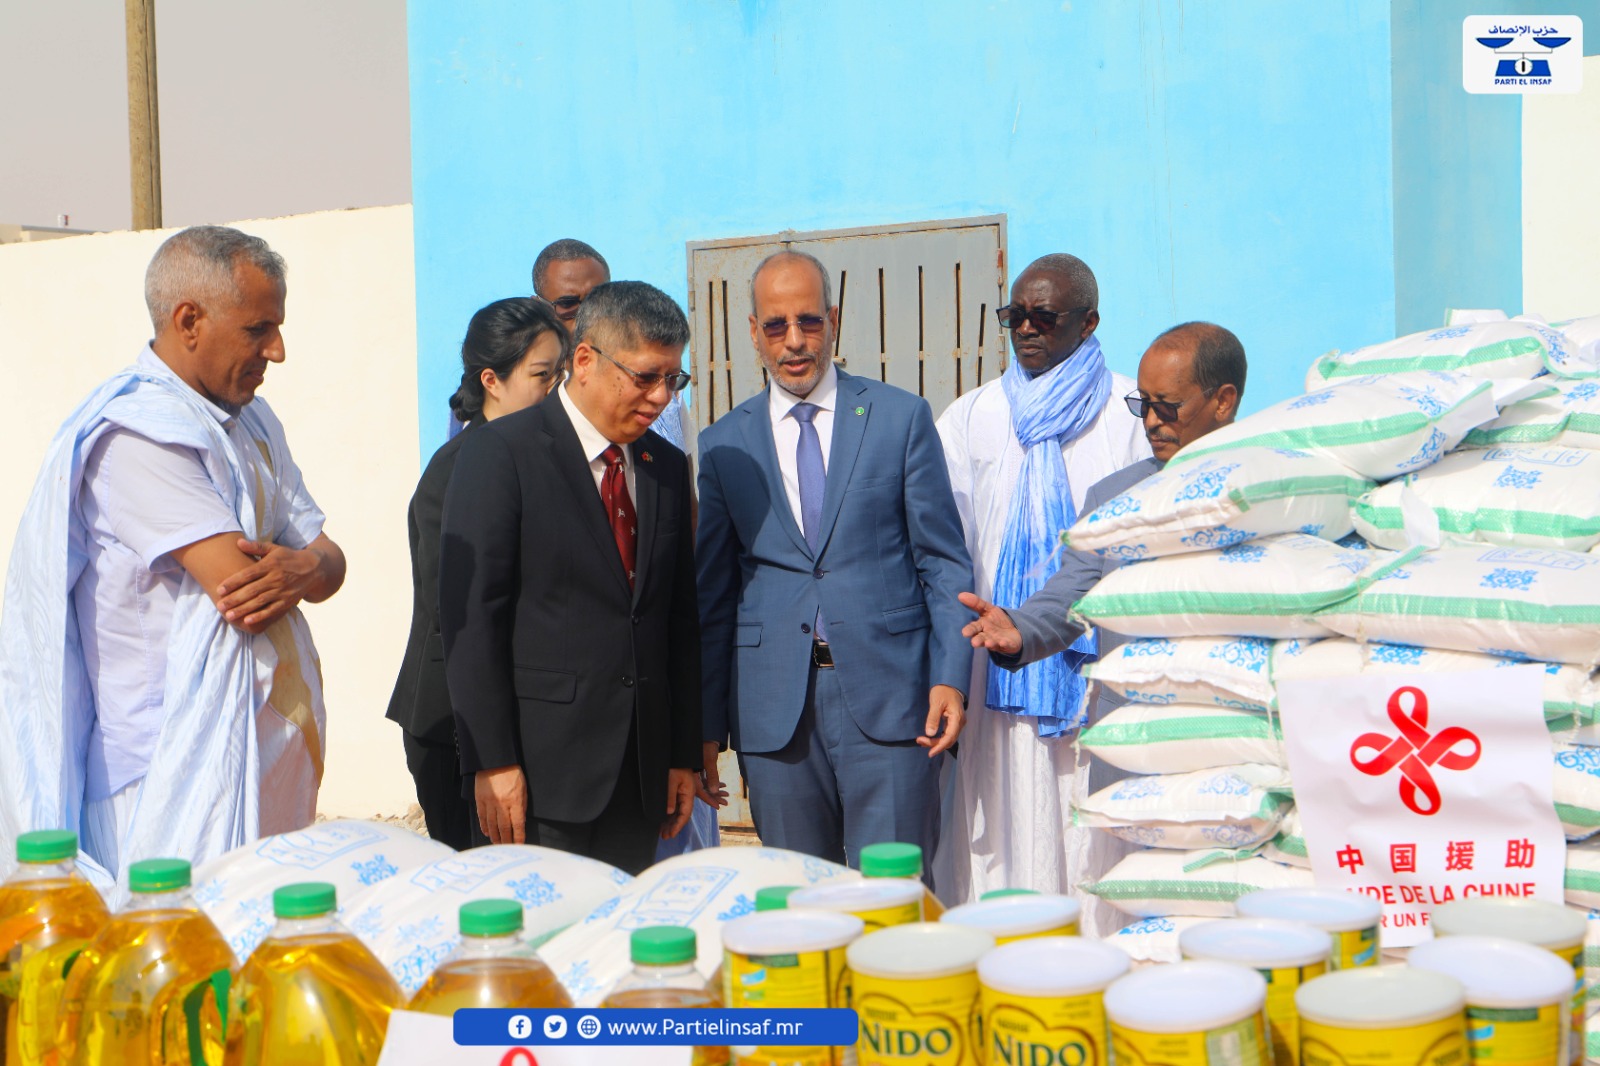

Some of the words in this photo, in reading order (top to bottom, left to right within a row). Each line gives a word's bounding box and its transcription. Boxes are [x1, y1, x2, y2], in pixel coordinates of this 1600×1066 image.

[1336, 838, 1535, 874] 中国援助
[1399, 885, 1428, 904] DE
[1429, 885, 1455, 905] LA
[1463, 882, 1535, 898] CHINE
[1394, 912, 1416, 927] UN
[860, 1018, 953, 1056] NIDO
[992, 1028, 1087, 1066] NIDO
